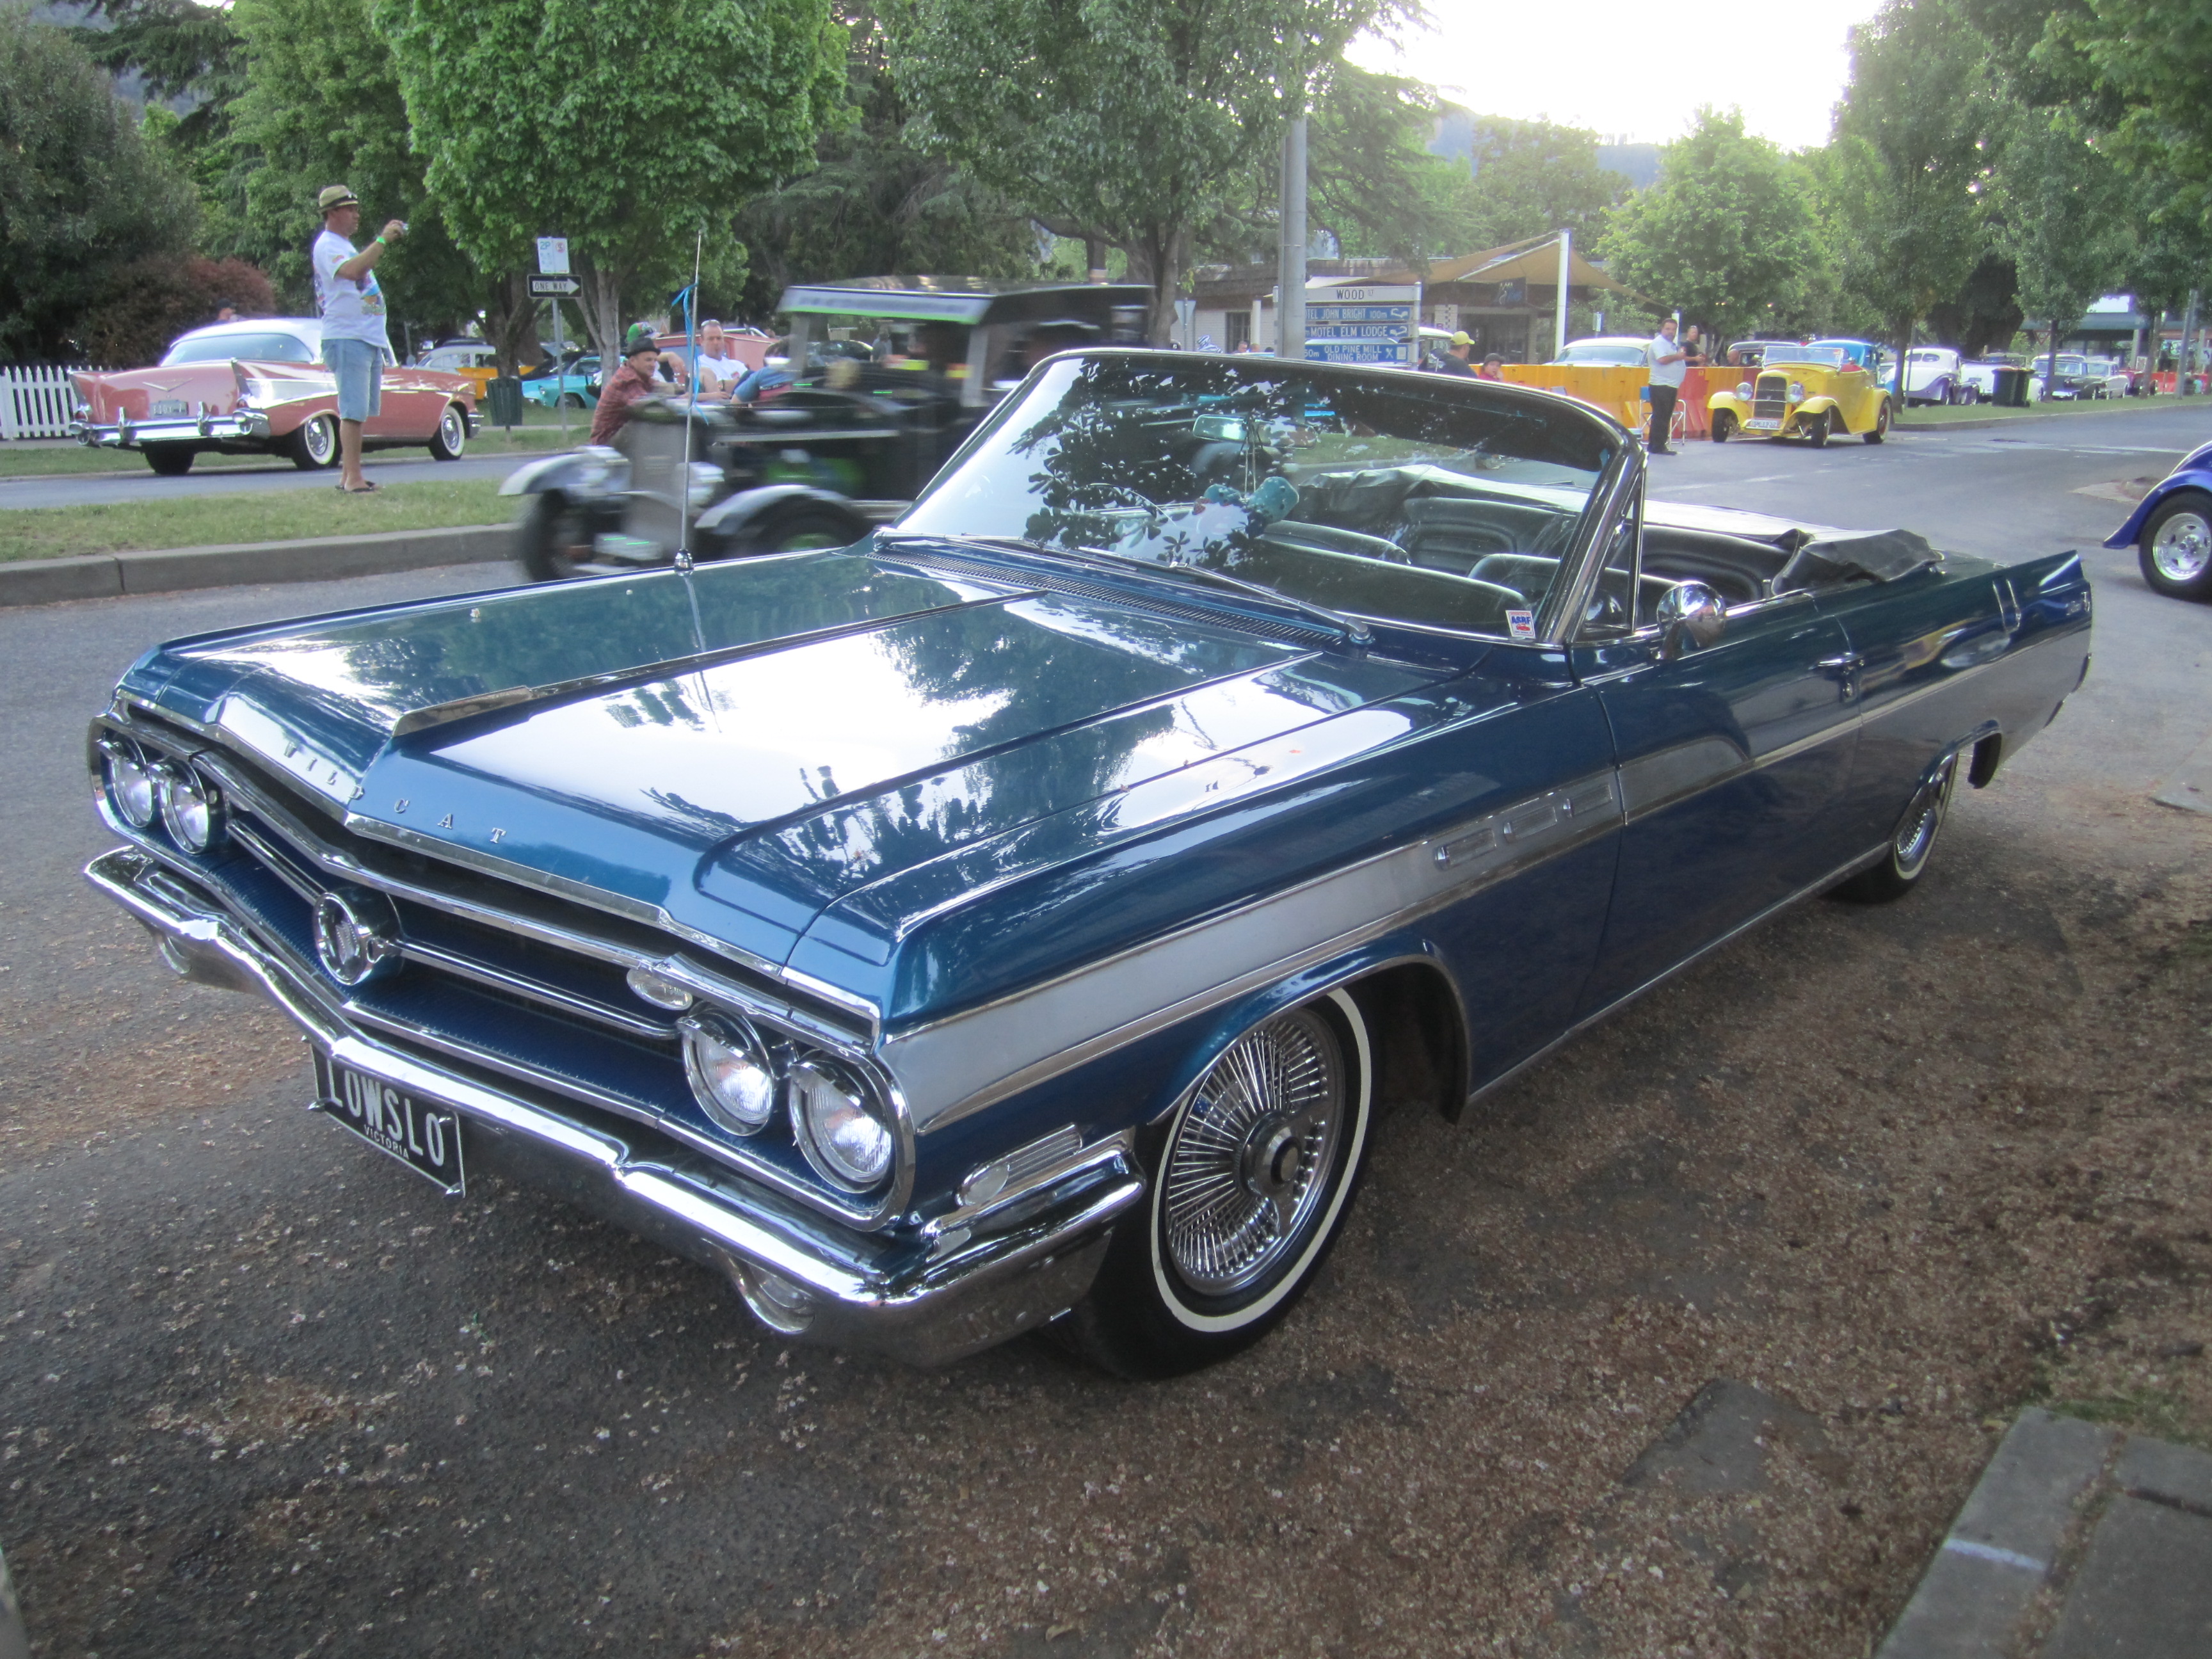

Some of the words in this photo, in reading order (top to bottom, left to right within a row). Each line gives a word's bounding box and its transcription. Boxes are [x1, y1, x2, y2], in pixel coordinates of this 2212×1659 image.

[540, 241, 550, 250] 2P
[534, 282, 549, 291] ONE
[553, 282, 567, 291] WAY
[1336, 289, 1365, 300] WOOD
[1305, 308, 1318, 319] OTEL
[1322, 308, 1340, 319] JOHN
[1342, 308, 1366, 319] BRIGHT
[1370, 310, 1388, 319] 100m
[1310, 326, 1336, 337] MOTEL
[1341, 326, 1357, 337] ELM
[1361, 326, 1388, 337] LODGE
[1324, 345, 1340, 353] OLD
[1342, 345, 1361, 353] PINE
[1363, 345, 1382, 353] MILL
[1327, 353, 1354, 361] DINING
[1356, 353, 1379, 361] ROOM
[326, 1059, 444, 1167] LOWSLO
[364, 1125, 410, 1160] VICTORIA
